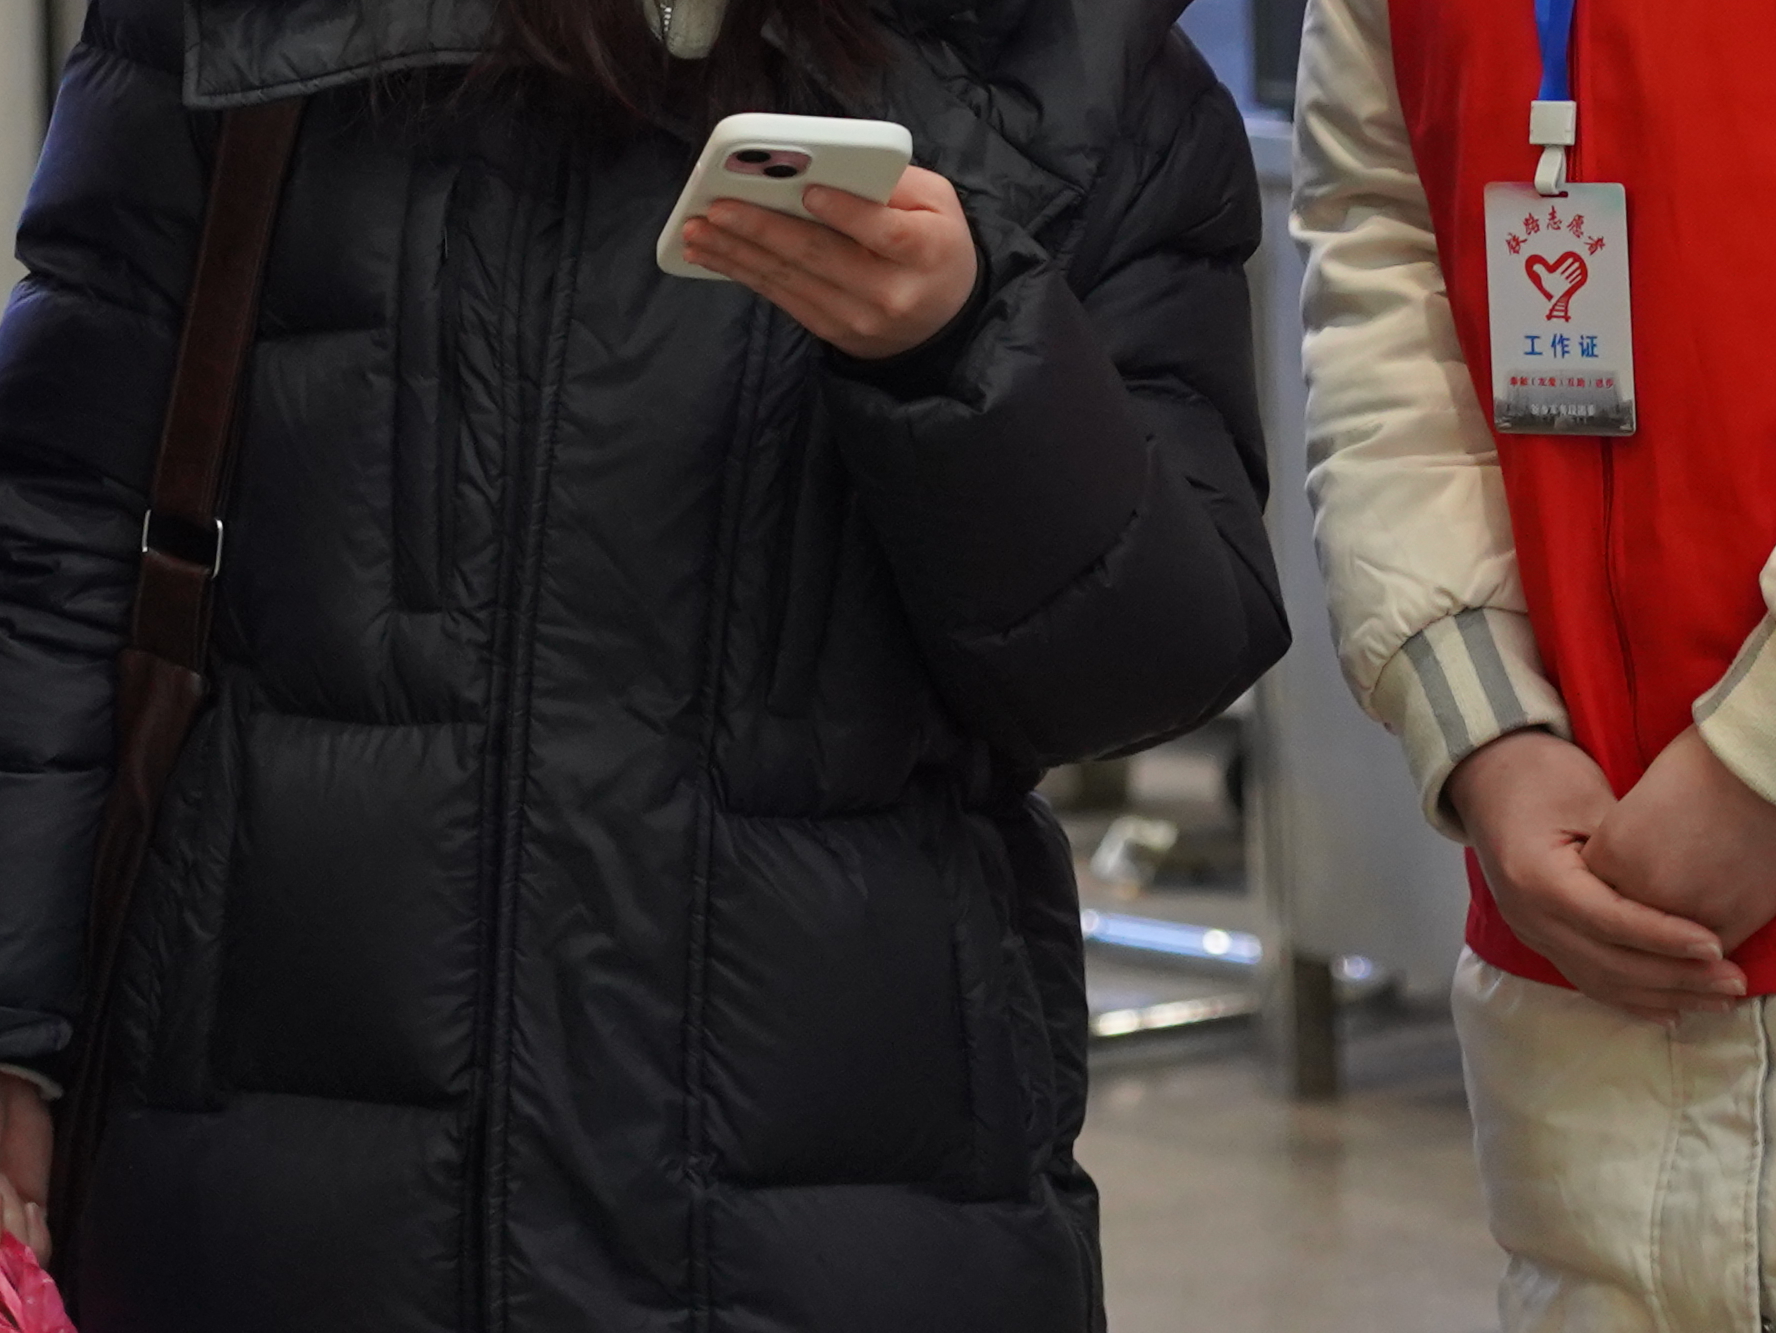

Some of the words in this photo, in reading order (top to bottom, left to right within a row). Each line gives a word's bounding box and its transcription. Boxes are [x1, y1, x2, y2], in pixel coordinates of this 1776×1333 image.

[1505, 205, 1607, 256] 铁路志愿者
[1524, 334, 1599, 359] 工作证
